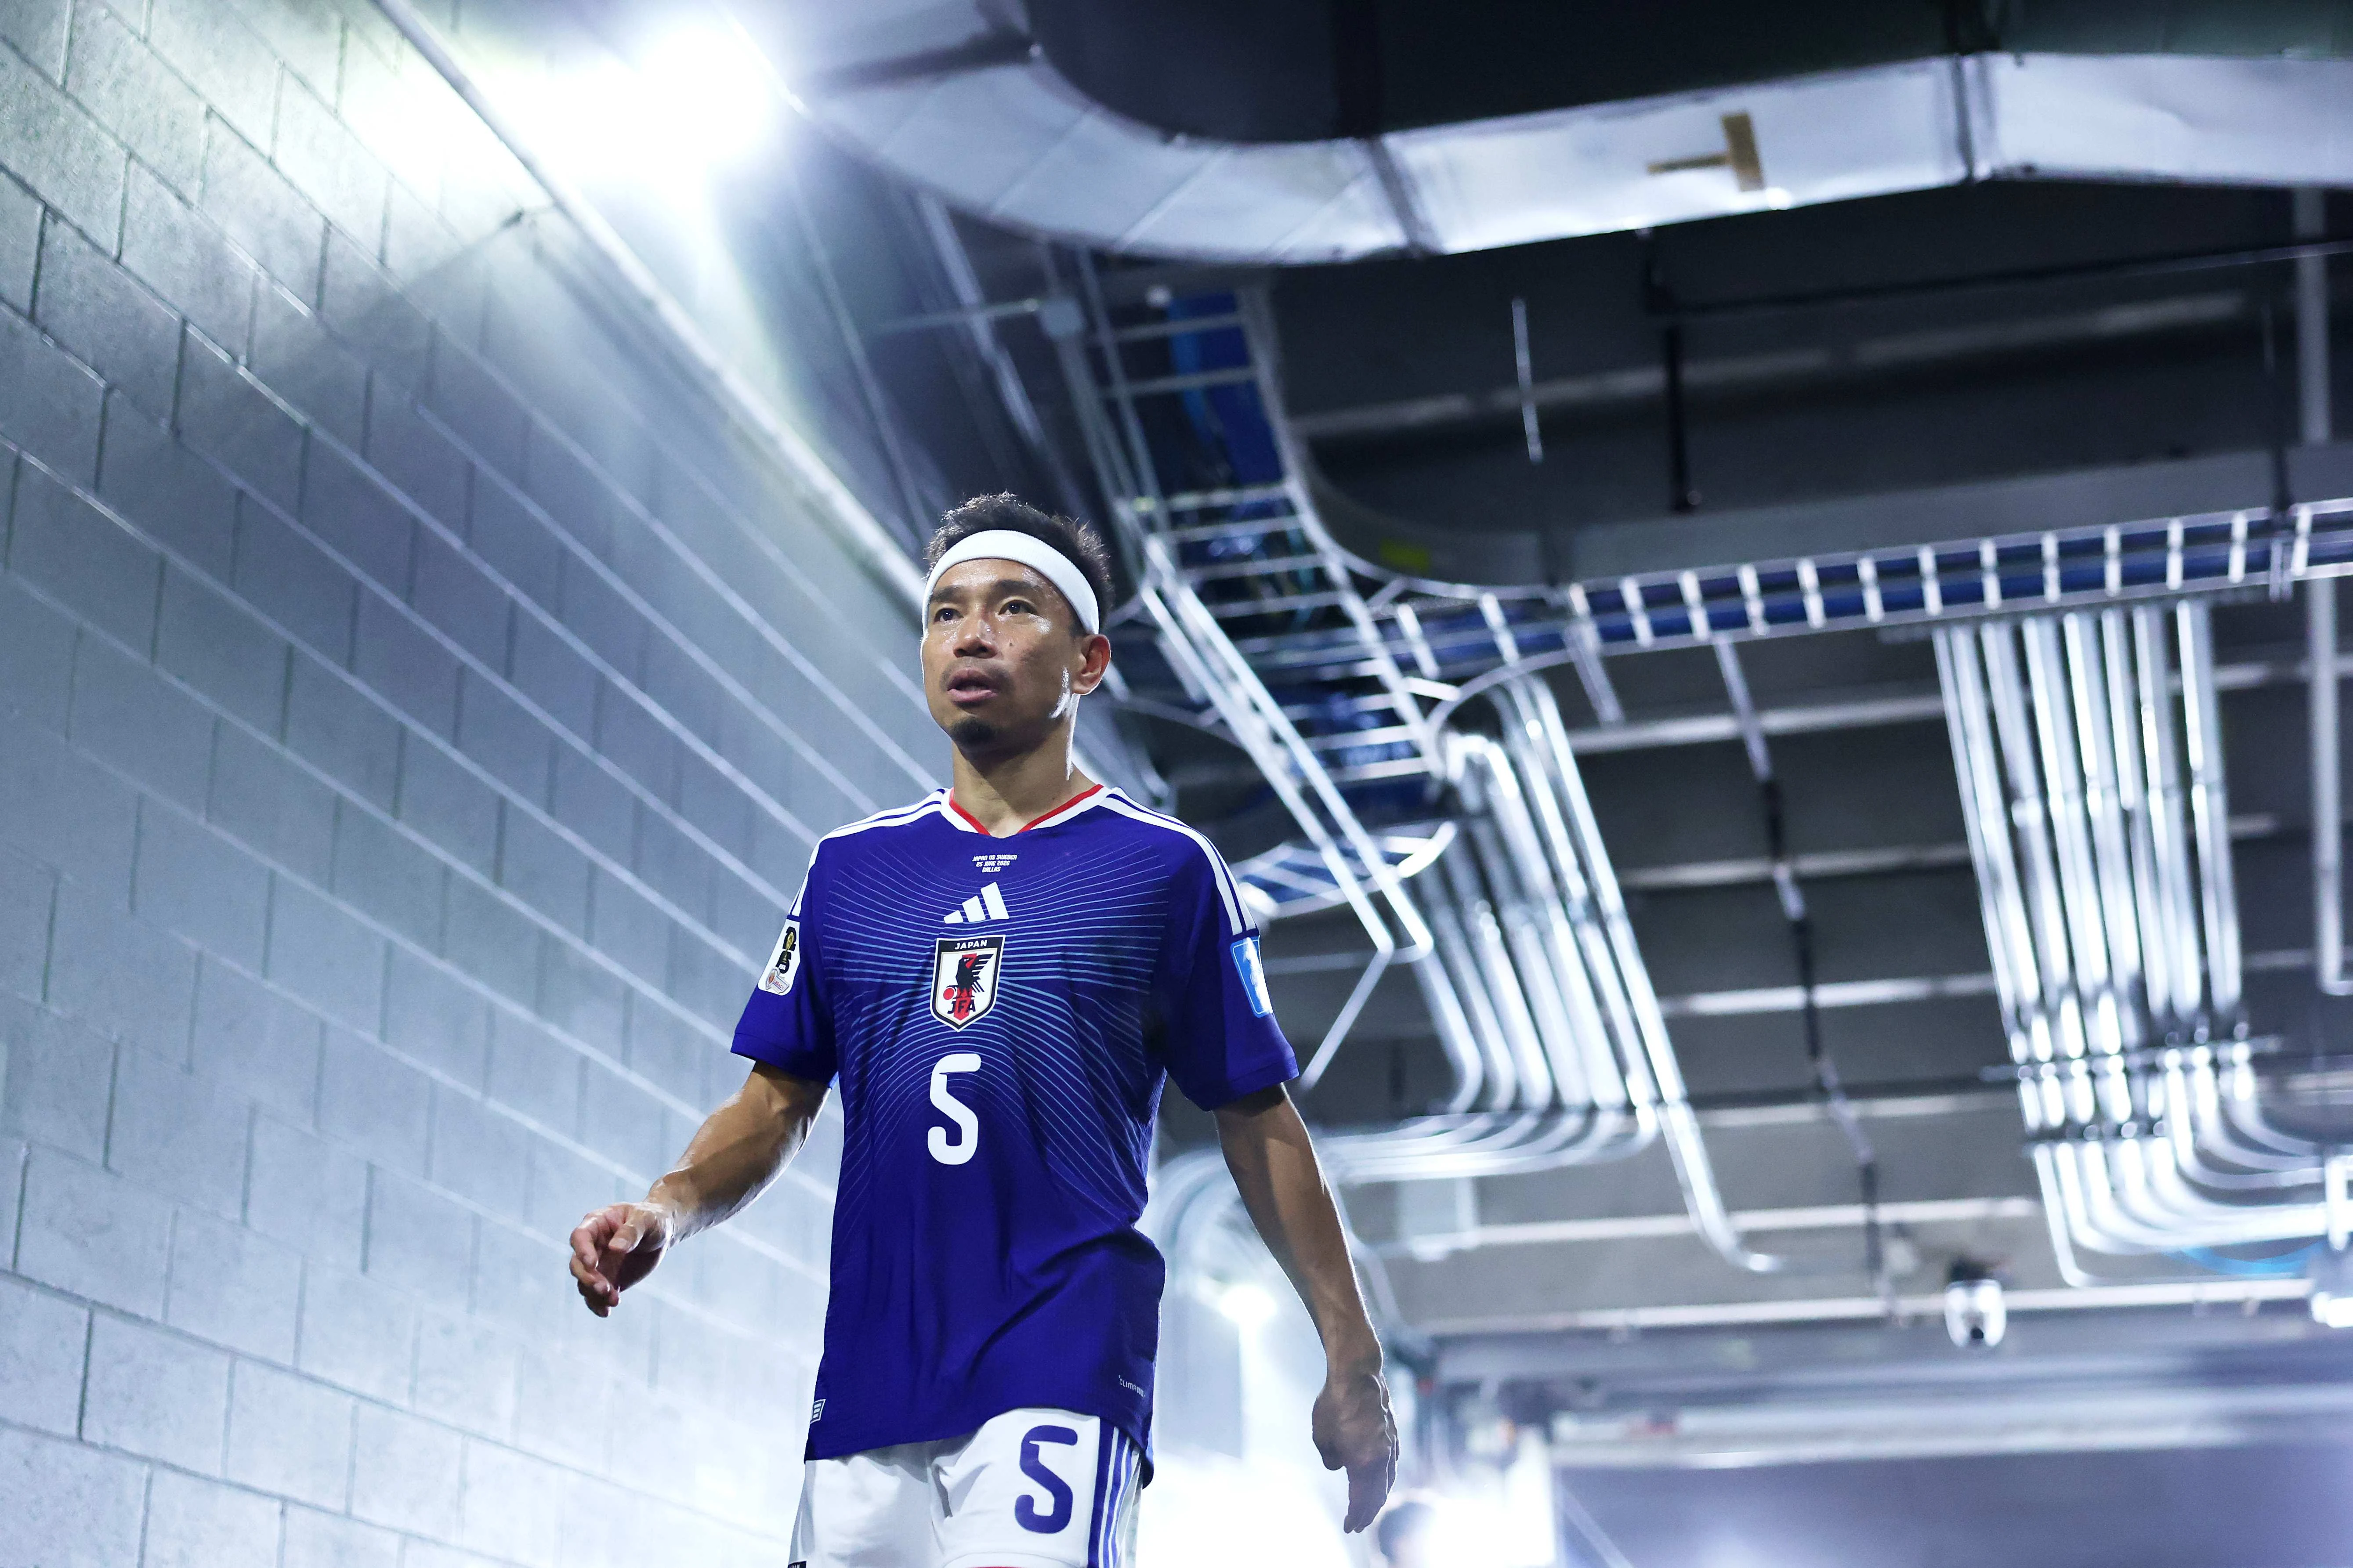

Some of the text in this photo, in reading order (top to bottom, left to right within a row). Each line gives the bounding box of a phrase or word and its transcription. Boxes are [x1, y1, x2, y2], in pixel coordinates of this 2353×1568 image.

[954, 939, 988, 950] JAPAN
[947, 999, 976, 1014] JFA
[927, 1054, 981, 1165] 5
[1015, 1425, 1078, 1534] 5
